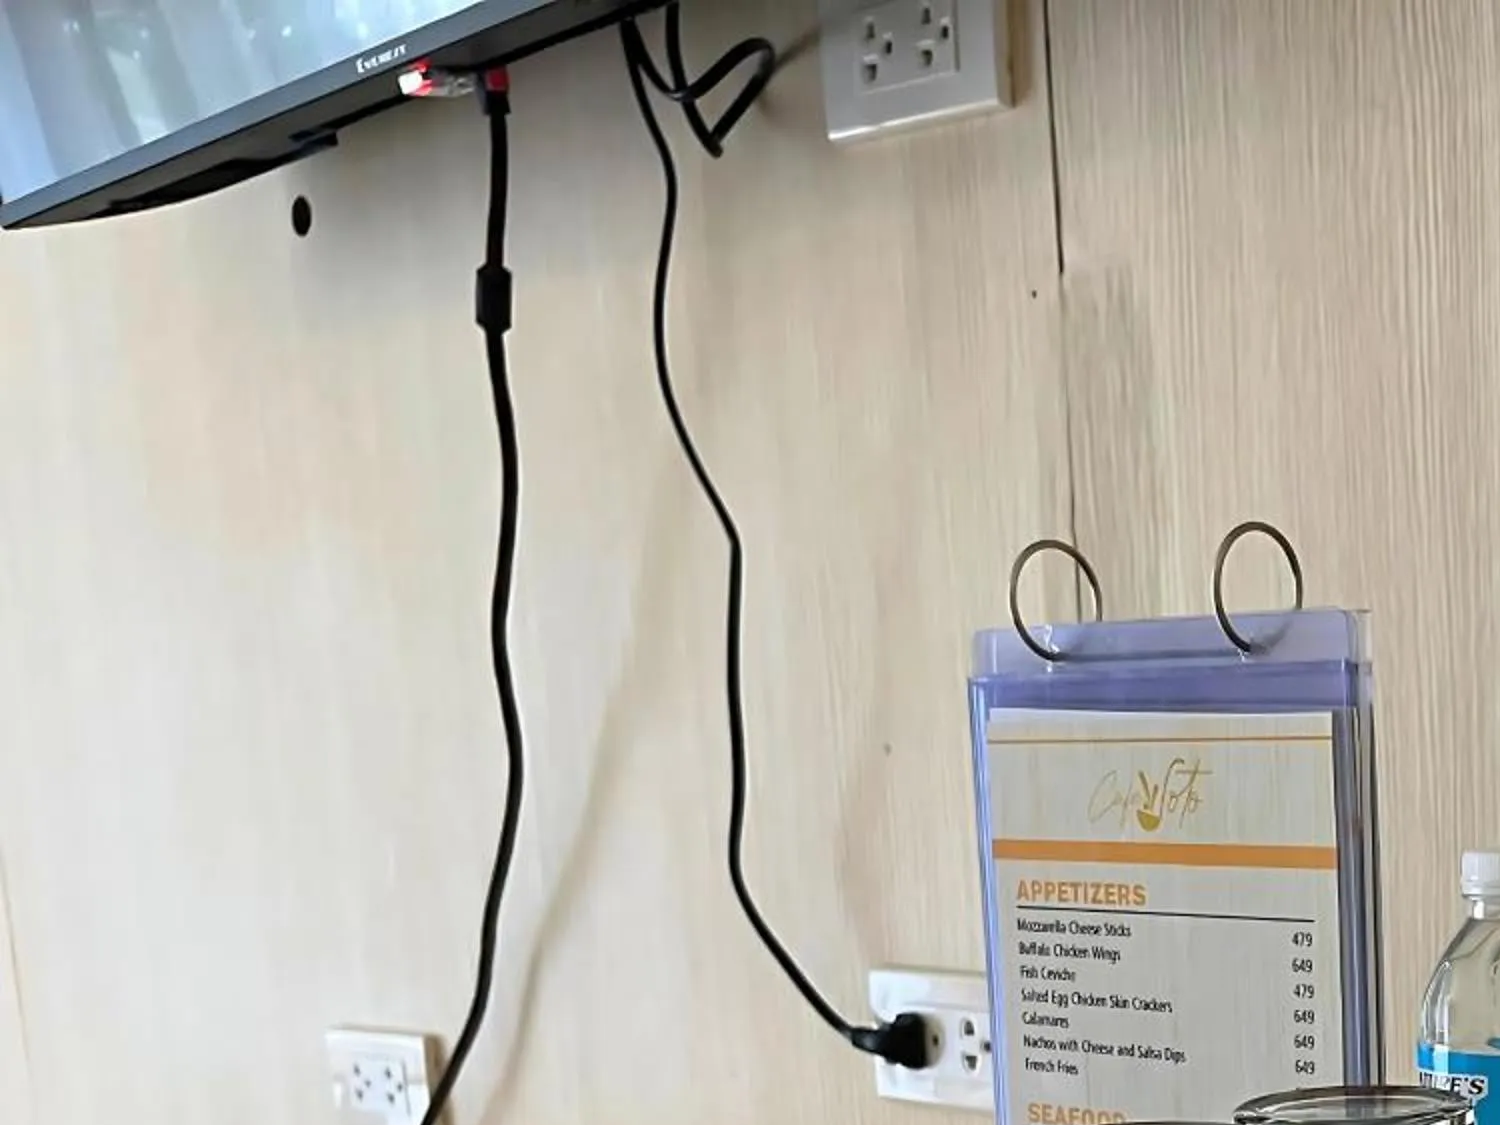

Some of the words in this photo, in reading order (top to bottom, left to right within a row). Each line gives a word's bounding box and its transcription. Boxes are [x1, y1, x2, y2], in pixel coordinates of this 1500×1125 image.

[1017, 879, 1147, 906] APPETIZERS
[1017, 918, 1067, 935] Mozzarella
[1069, 920, 1102, 936] Cheese
[1104, 922, 1132, 938] Sticks
[1292, 932, 1313, 947] 479
[1018, 941, 1051, 957] Buffalo
[1053, 943, 1089, 959] Chicken
[1092, 946, 1122, 965] Wings
[1292, 957, 1313, 973] 649
[1020, 965, 1039, 980] Fish
[1293, 984, 1315, 999] 479
[1021, 988, 1049, 1004] Salted
[1051, 990, 1069, 1008] Egg
[1071, 992, 1107, 1008] Chicken
[1132, 997, 1173, 1013] Crackers
[1294, 1009, 1316, 1025] 649
[1022, 1011, 1070, 1029] Calamares
[1294, 1035, 1316, 1050] 649
[1023, 1034, 1056, 1051] Nachos
[1059, 1038, 1079, 1052] with
[1081, 1039, 1114, 1056] Cheese
[1117, 1043, 1135, 1058] and
[1137, 1046, 1163, 1060] Salsa
[1164, 1047, 1187, 1064] Dips
[1025, 1057, 1055, 1073] French
[1057, 1059, 1079, 1075] Fries
